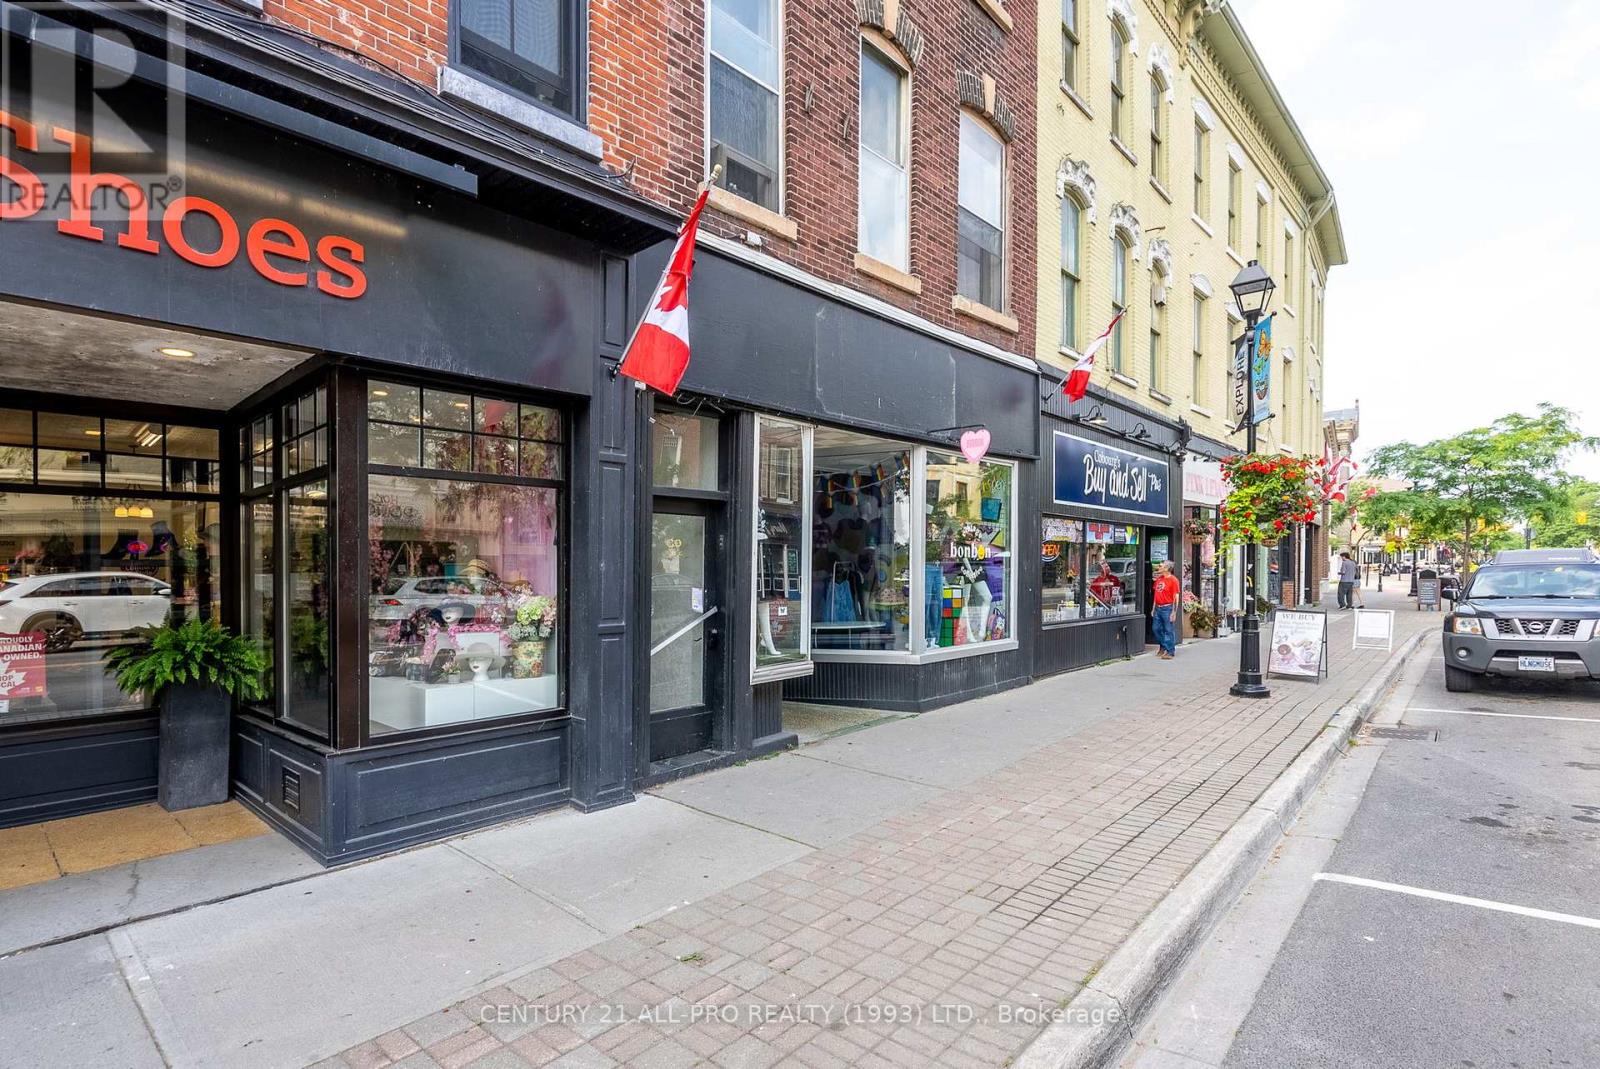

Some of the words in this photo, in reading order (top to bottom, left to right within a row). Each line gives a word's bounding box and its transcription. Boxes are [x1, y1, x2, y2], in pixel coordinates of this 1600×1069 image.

[1235, 350, 1245, 416] EXPLORE
[1083, 453, 1107, 504] Buy
[1109, 462, 1130, 498] and
[1130, 466, 1147, 502] Sell
[0, 643, 42, 652] ANADIAN
